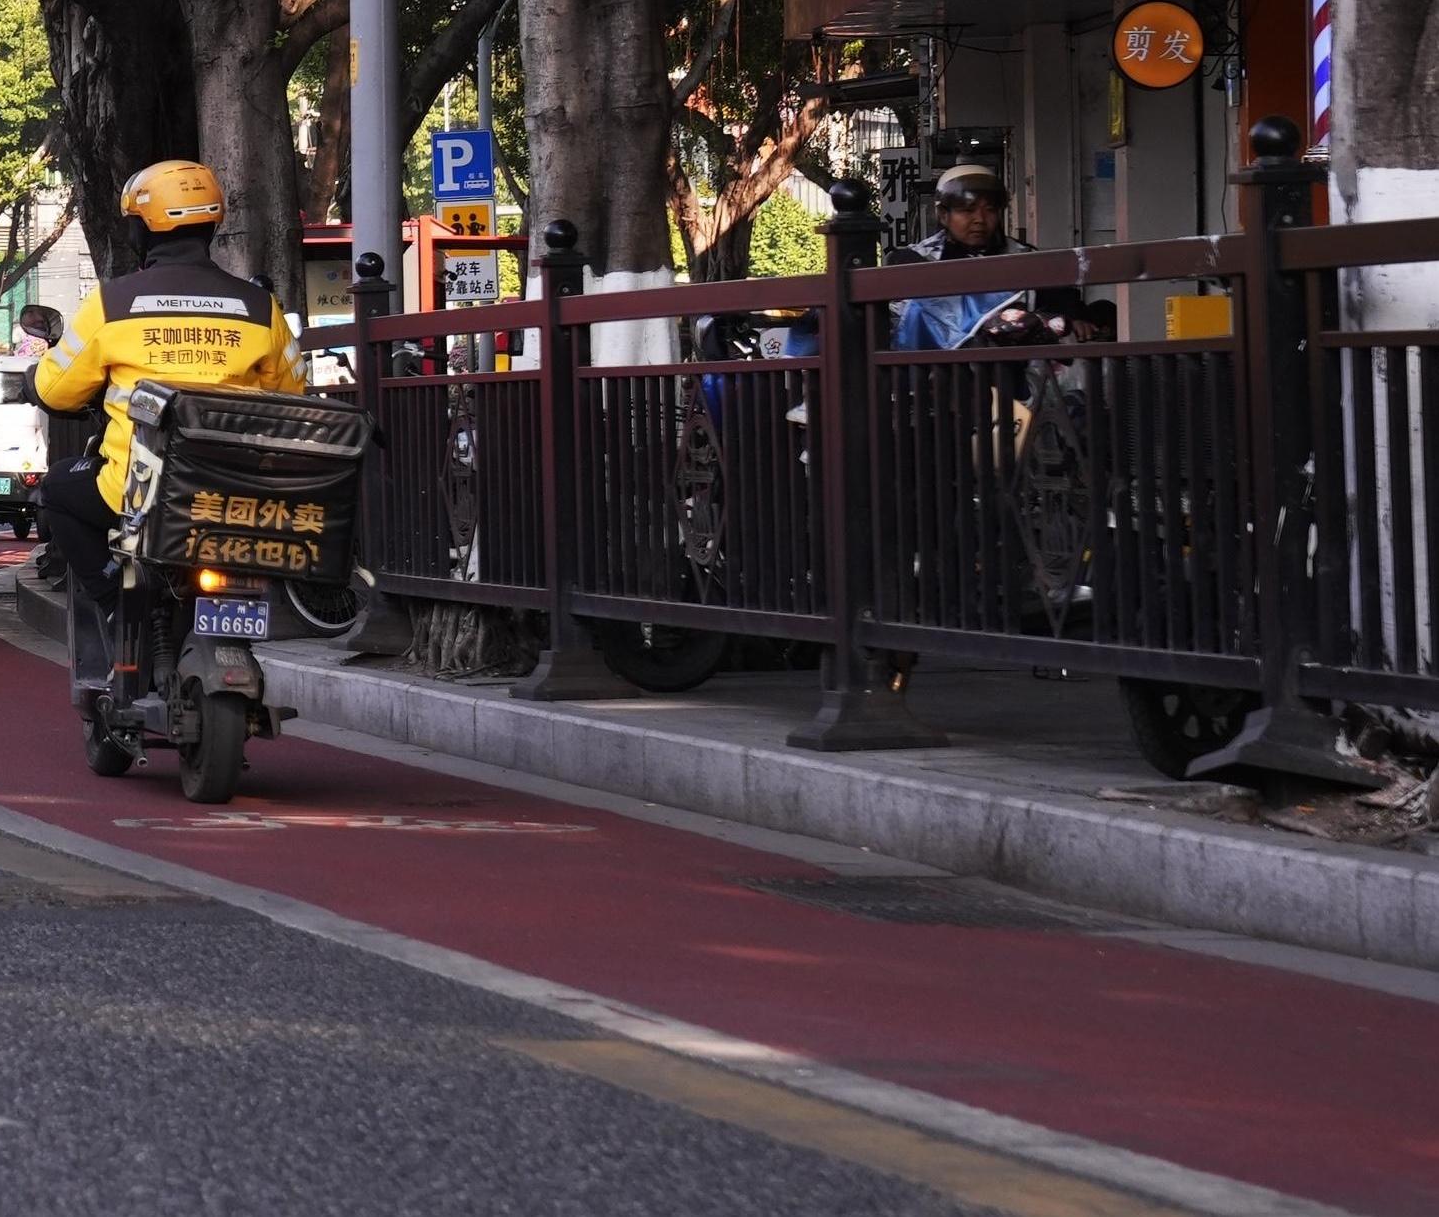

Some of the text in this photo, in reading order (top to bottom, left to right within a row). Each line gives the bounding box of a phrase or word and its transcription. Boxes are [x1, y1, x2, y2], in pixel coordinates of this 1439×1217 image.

[1123, 26, 1195, 63] 剪发
[437, 139, 473, 191] P
[156, 299, 223, 309] MEITUAN
[142, 327, 242, 347] 买咖啡奶茶
[144, 349, 228, 365] 上美团外卖
[190, 491, 324, 533] 美团外卖
[198, 615, 265, 634] S16650
